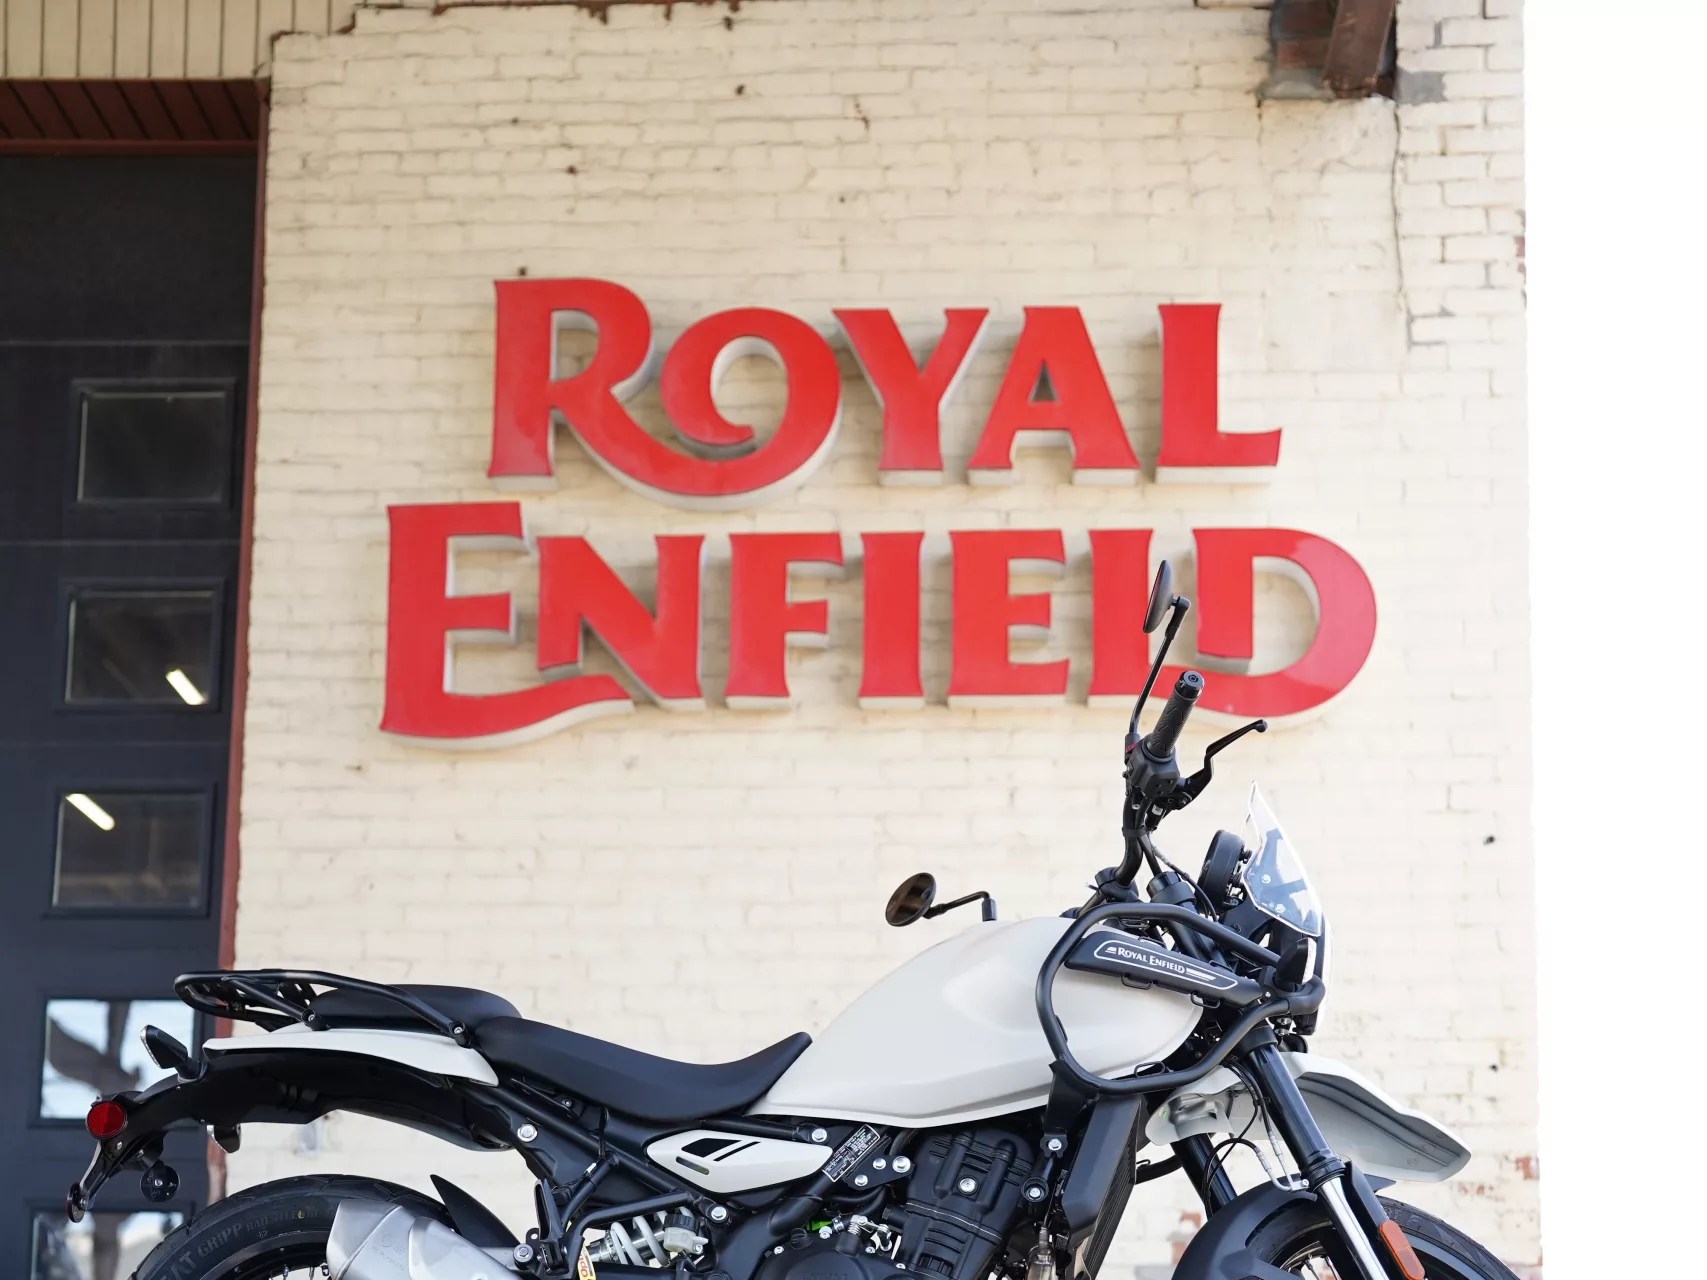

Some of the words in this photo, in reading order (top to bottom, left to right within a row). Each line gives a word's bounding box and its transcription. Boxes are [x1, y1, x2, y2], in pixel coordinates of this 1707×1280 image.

[487, 278, 1282, 498] ROYAL
[380, 501, 1378, 739] ENFIELD
[1117, 946, 1147, 962] ROYAL
[1149, 956, 1186, 974] ENFIELD
